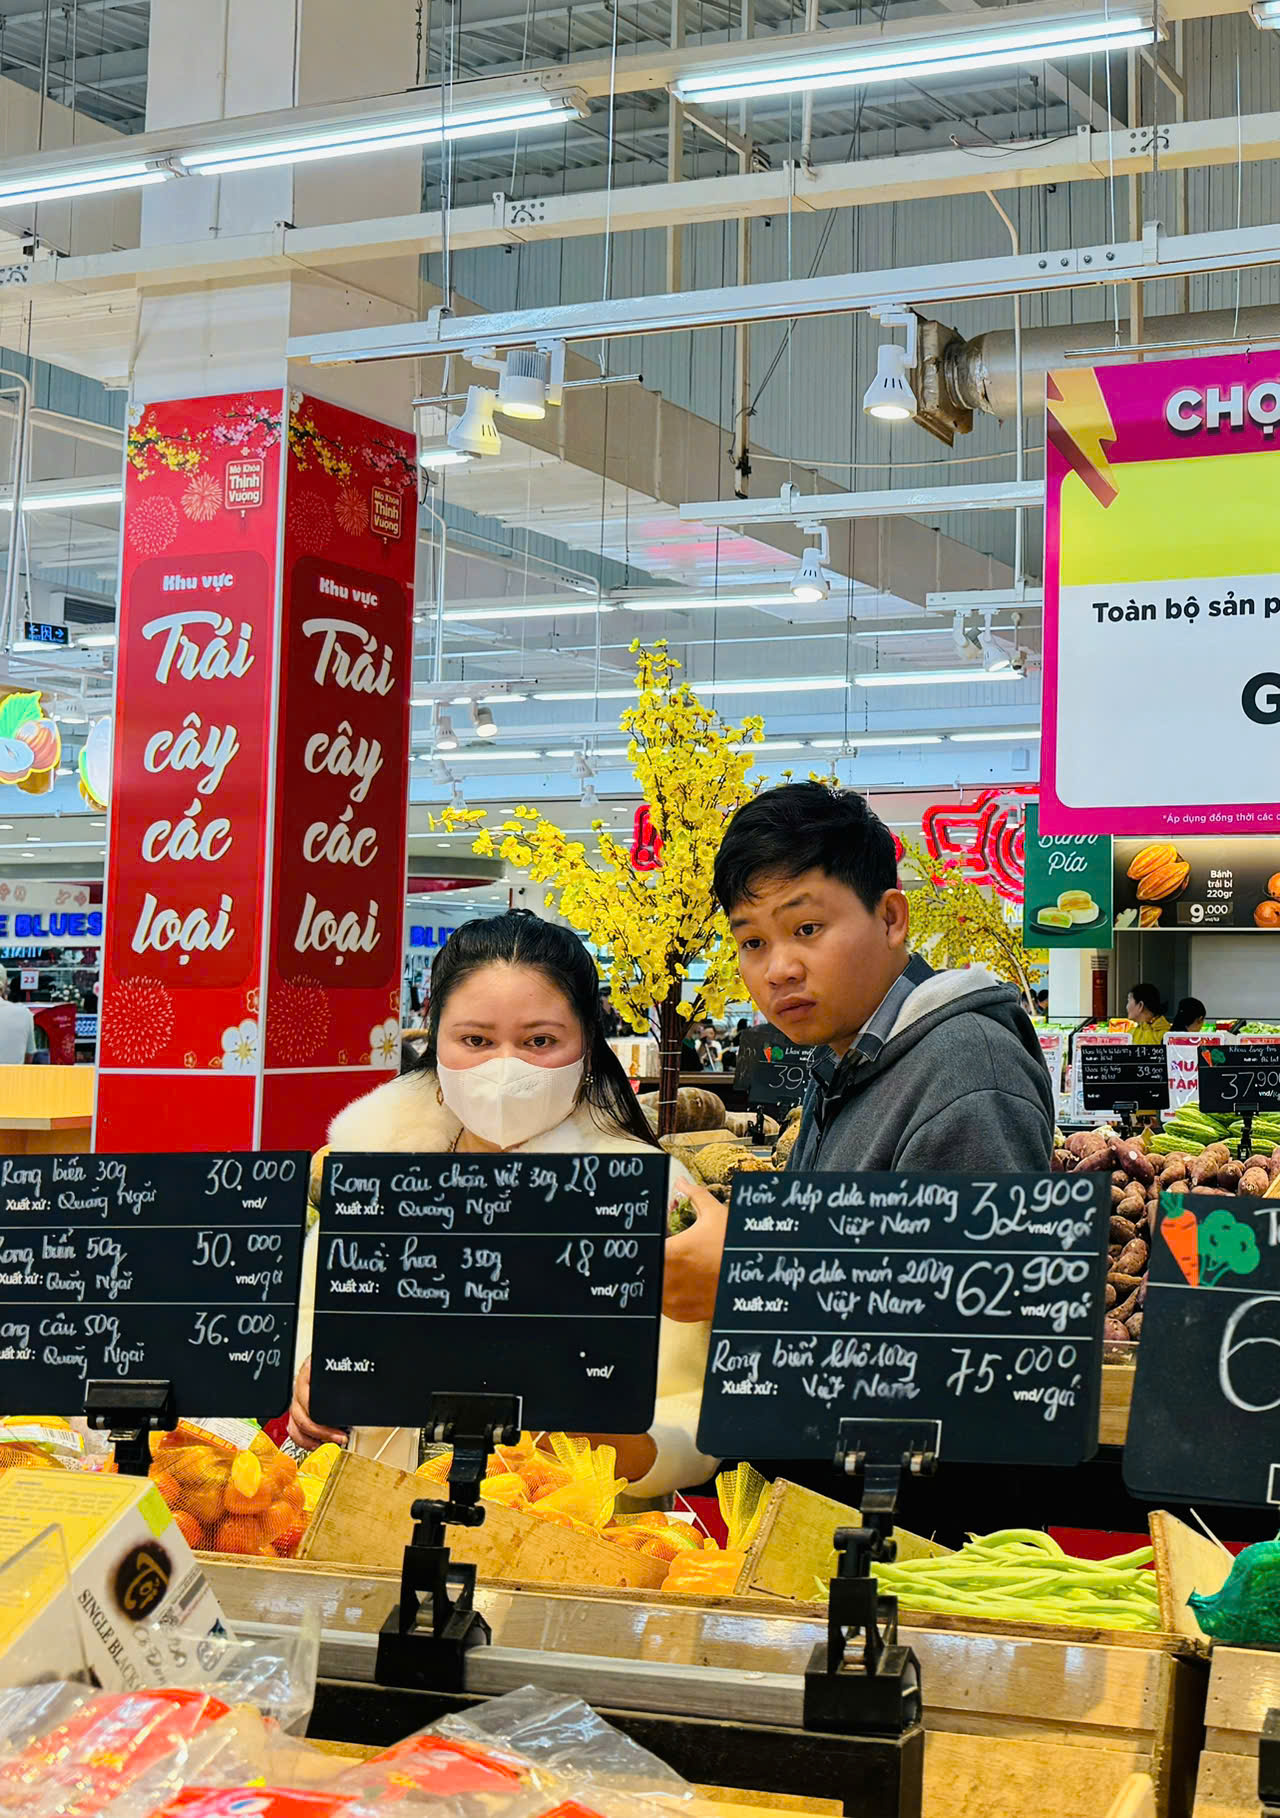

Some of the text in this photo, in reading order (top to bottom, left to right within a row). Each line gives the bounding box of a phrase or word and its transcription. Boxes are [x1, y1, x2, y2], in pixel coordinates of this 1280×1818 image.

[162, 572, 234, 592] Khu vực
[320, 578, 378, 608] Khu vực
[1093, 598, 1157, 623] Toàn
[1165, 596, 1200, 624] bộ
[1208, 591, 1255, 617] sản
[141, 610, 255, 684] Trái
[303, 618, 398, 697] Trái
[143, 711, 239, 795] cây
[304, 720, 384, 802] cây
[141, 798, 233, 862] các
[1183, 813, 1207, 824] dụng
[1258, 812, 1273, 821] các
[303, 805, 378, 867] các
[1048, 851, 1088, 876] Pía
[1211, 870, 1233, 878] Bánh
[1207, 890, 1233, 899] 220gr
[15, 912, 103, 937] BLUES
[1190, 904, 1228, 923] 9.000
[131, 893, 235, 965] loại
[294, 893, 381, 966] loại
[205, 1159, 296, 1195] 30.000
[5, 1197, 268, 1211] Xuất xứ: vnd/
[335, 1201, 385, 1215] Xuất xứ:
[744, 1217, 775, 1232] Xuất
[776, 1219, 800, 1232] xứ:
[880, 1213, 931, 1235] Nam
[192, 1231, 282, 1267] 50.000
[330, 1278, 380, 1294] Xuất xứ:
[733, 1296, 763, 1312] Xuất
[765, 1298, 789, 1312] xứ:
[868, 1289, 926, 1315] Nam
[189, 1312, 275, 1346] 36.000
[325, 1358, 615, 1379] Xuất xứ: vnd/
[947, 1345, 1077, 1396] 75.000
[721, 1373, 921, 1401] Xuất xứ: Nam
[78, 1589, 115, 1644] SINGLE
